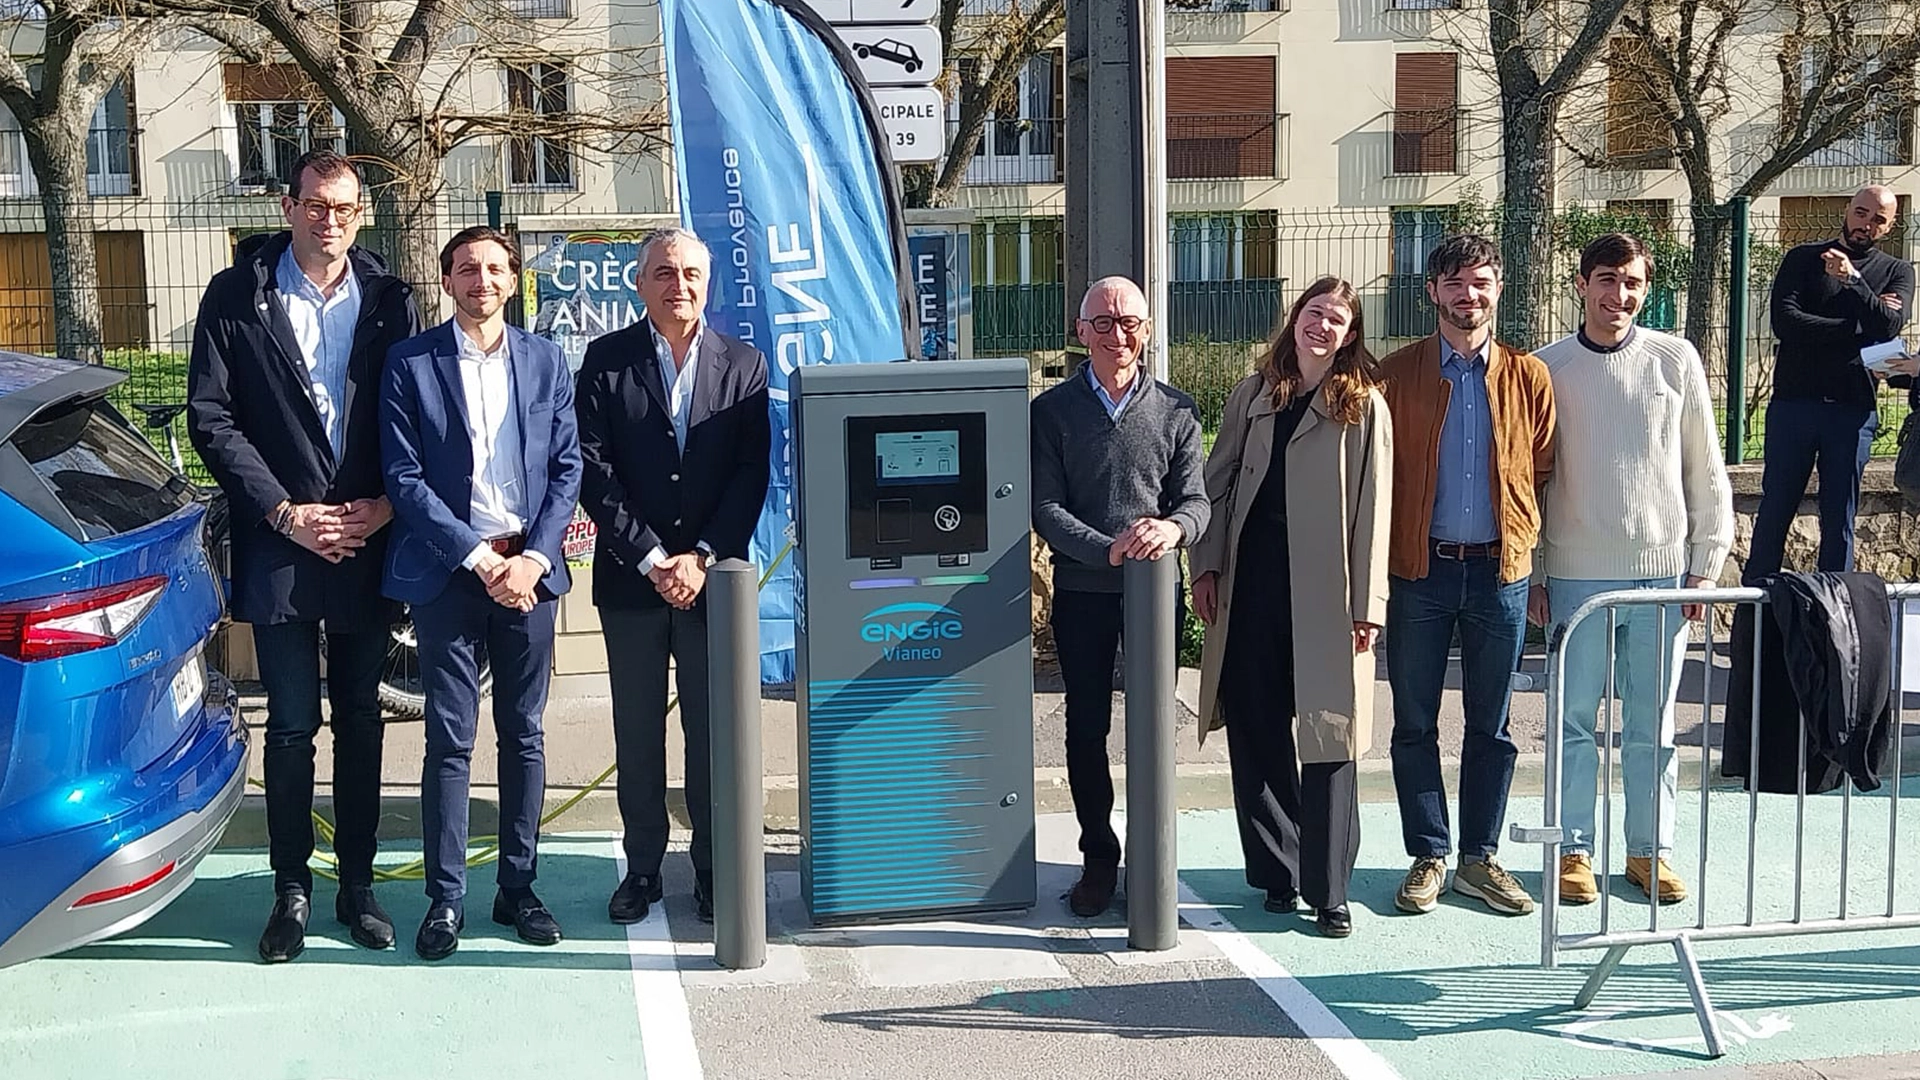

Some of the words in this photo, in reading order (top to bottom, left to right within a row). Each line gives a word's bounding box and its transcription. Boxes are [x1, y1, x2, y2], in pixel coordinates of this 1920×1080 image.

[881, 105, 935, 119] CIPALE
[896, 133, 915, 145] 39
[551, 251, 638, 292] CRÈC
[550, 300, 648, 332] ANIM
[564, 520, 599, 541] PPO
[564, 539, 594, 555] UROPE
[883, 647, 942, 661] Vianeo
